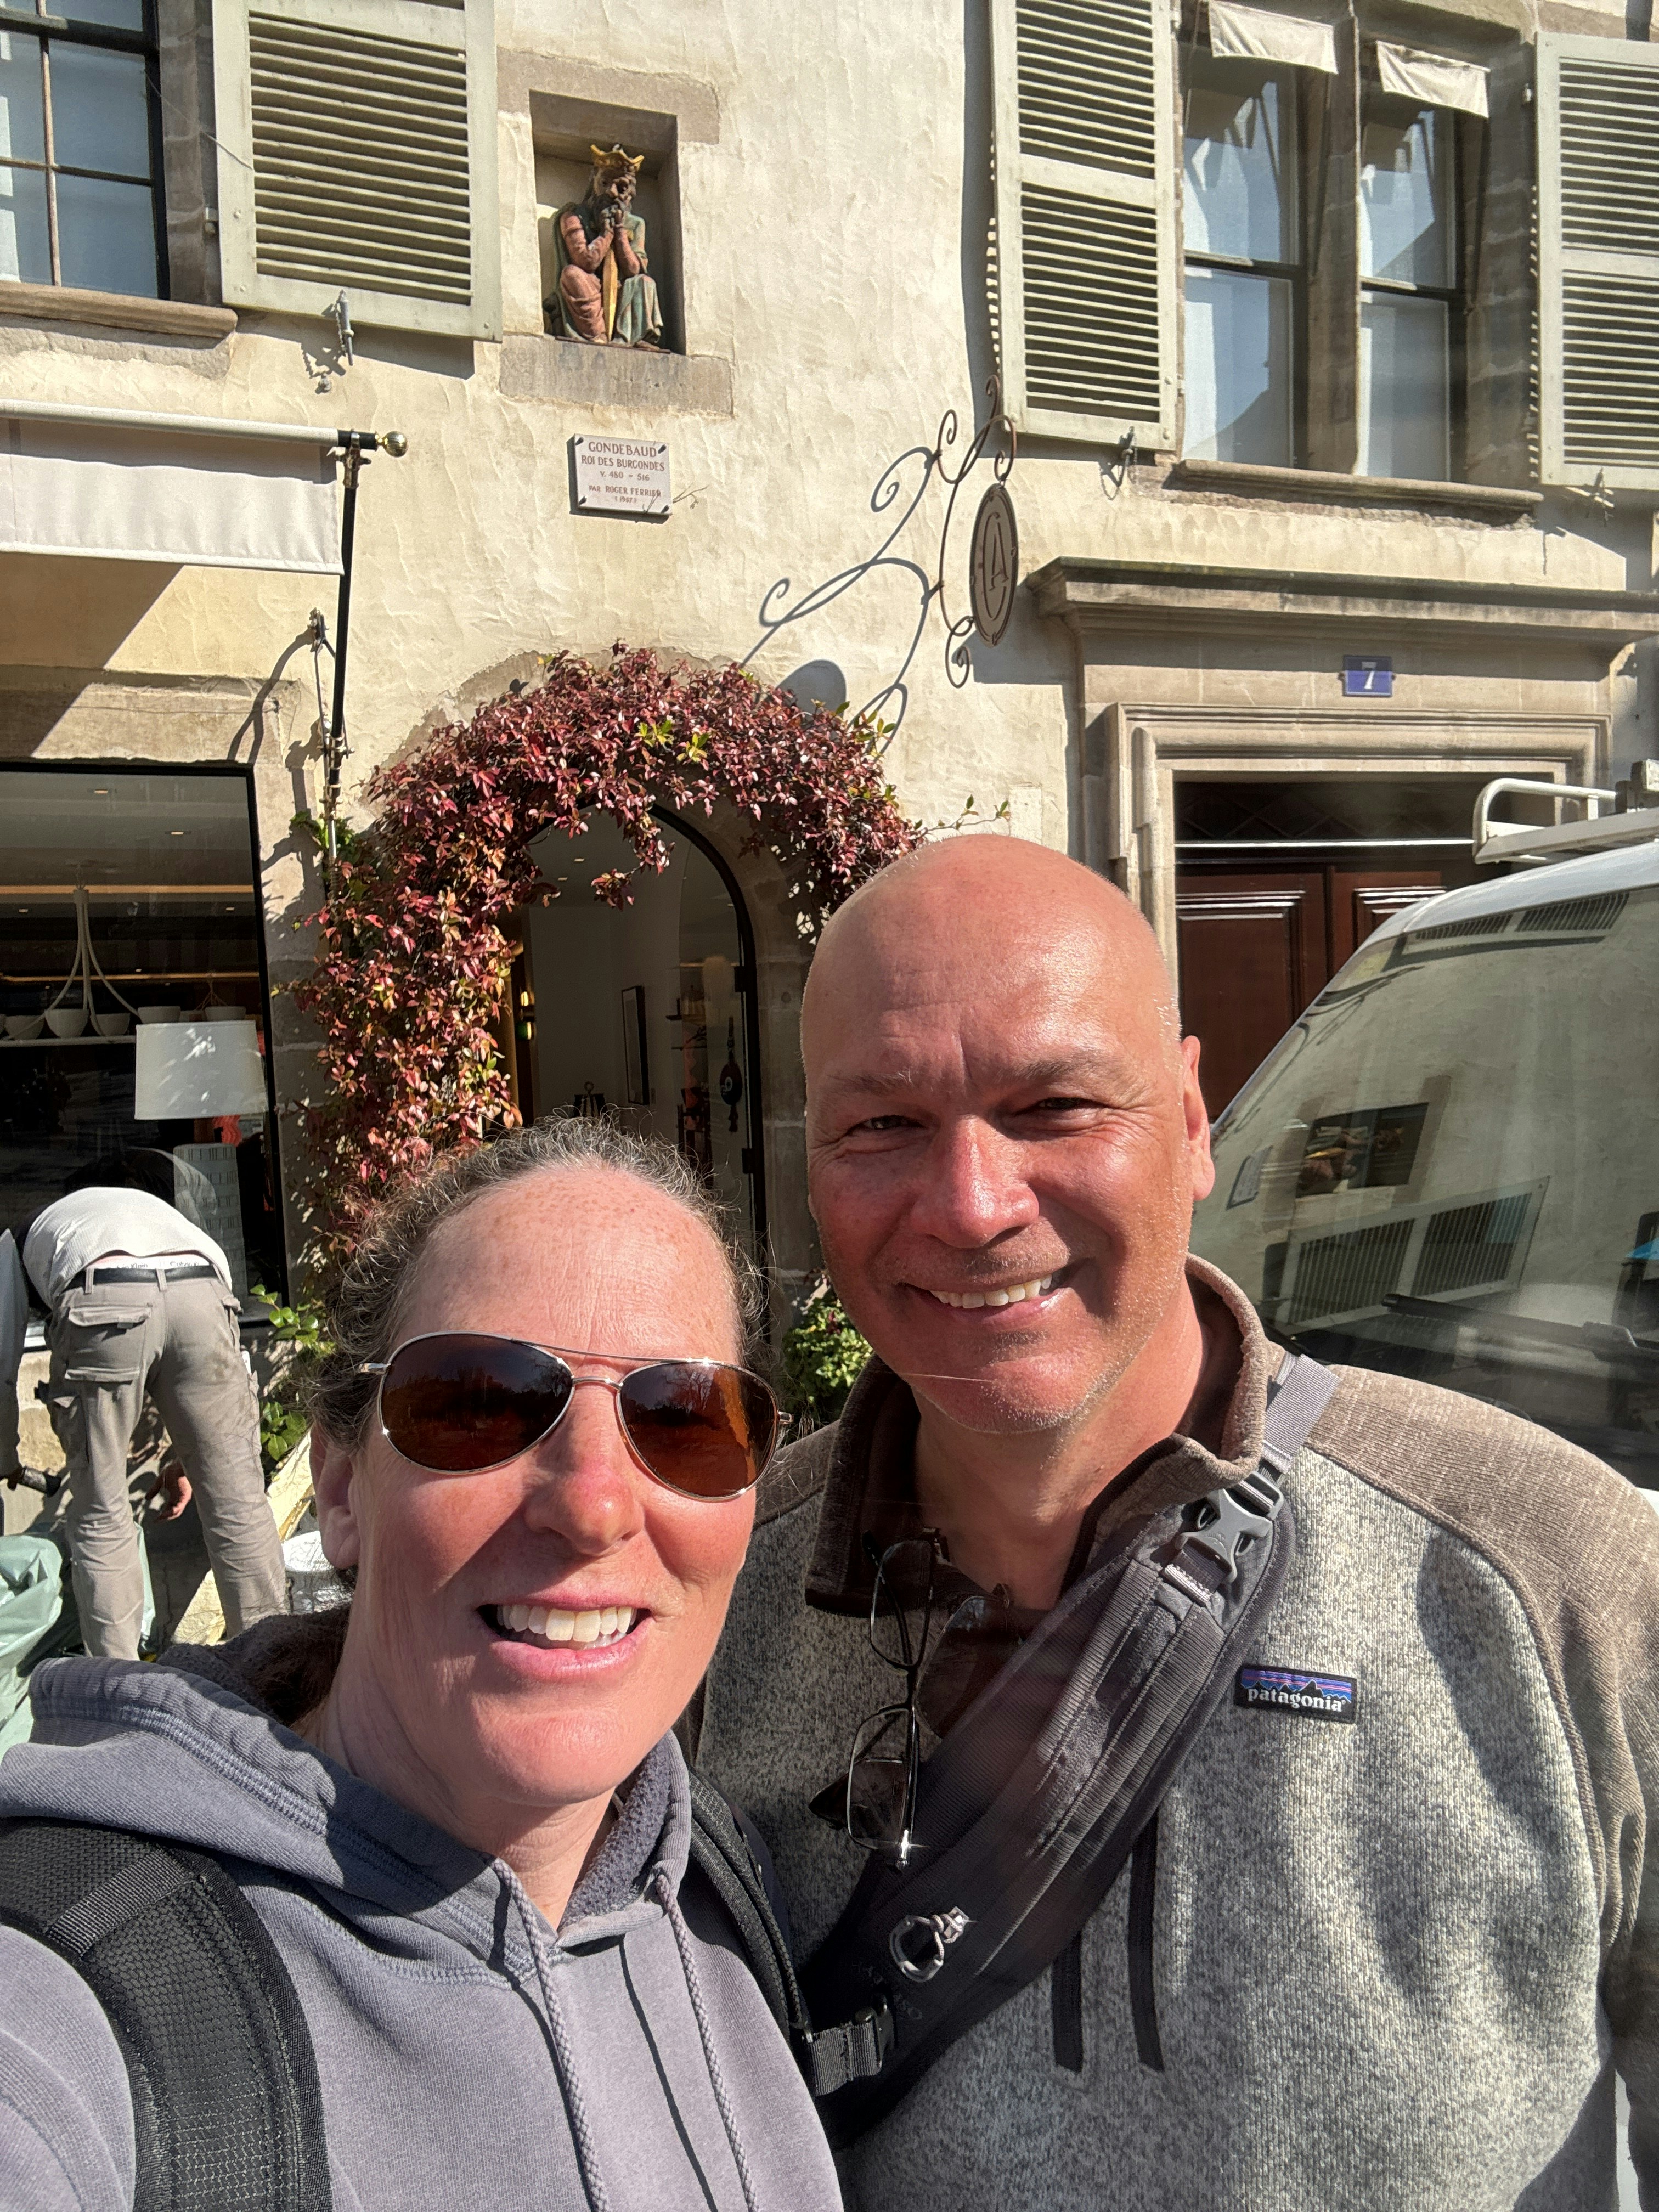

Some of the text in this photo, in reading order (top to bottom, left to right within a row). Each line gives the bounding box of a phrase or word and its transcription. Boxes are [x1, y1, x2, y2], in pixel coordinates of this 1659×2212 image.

[589, 442, 657, 457] GONDEBAUD
[582, 455, 665, 471] ROI DES BURGONDES
[605, 485, 628, 494] ROGER
[631, 488, 662, 497] FERRIER
[1361, 661, 1377, 689] 7
[1248, 1688, 1342, 1712] patagonia
